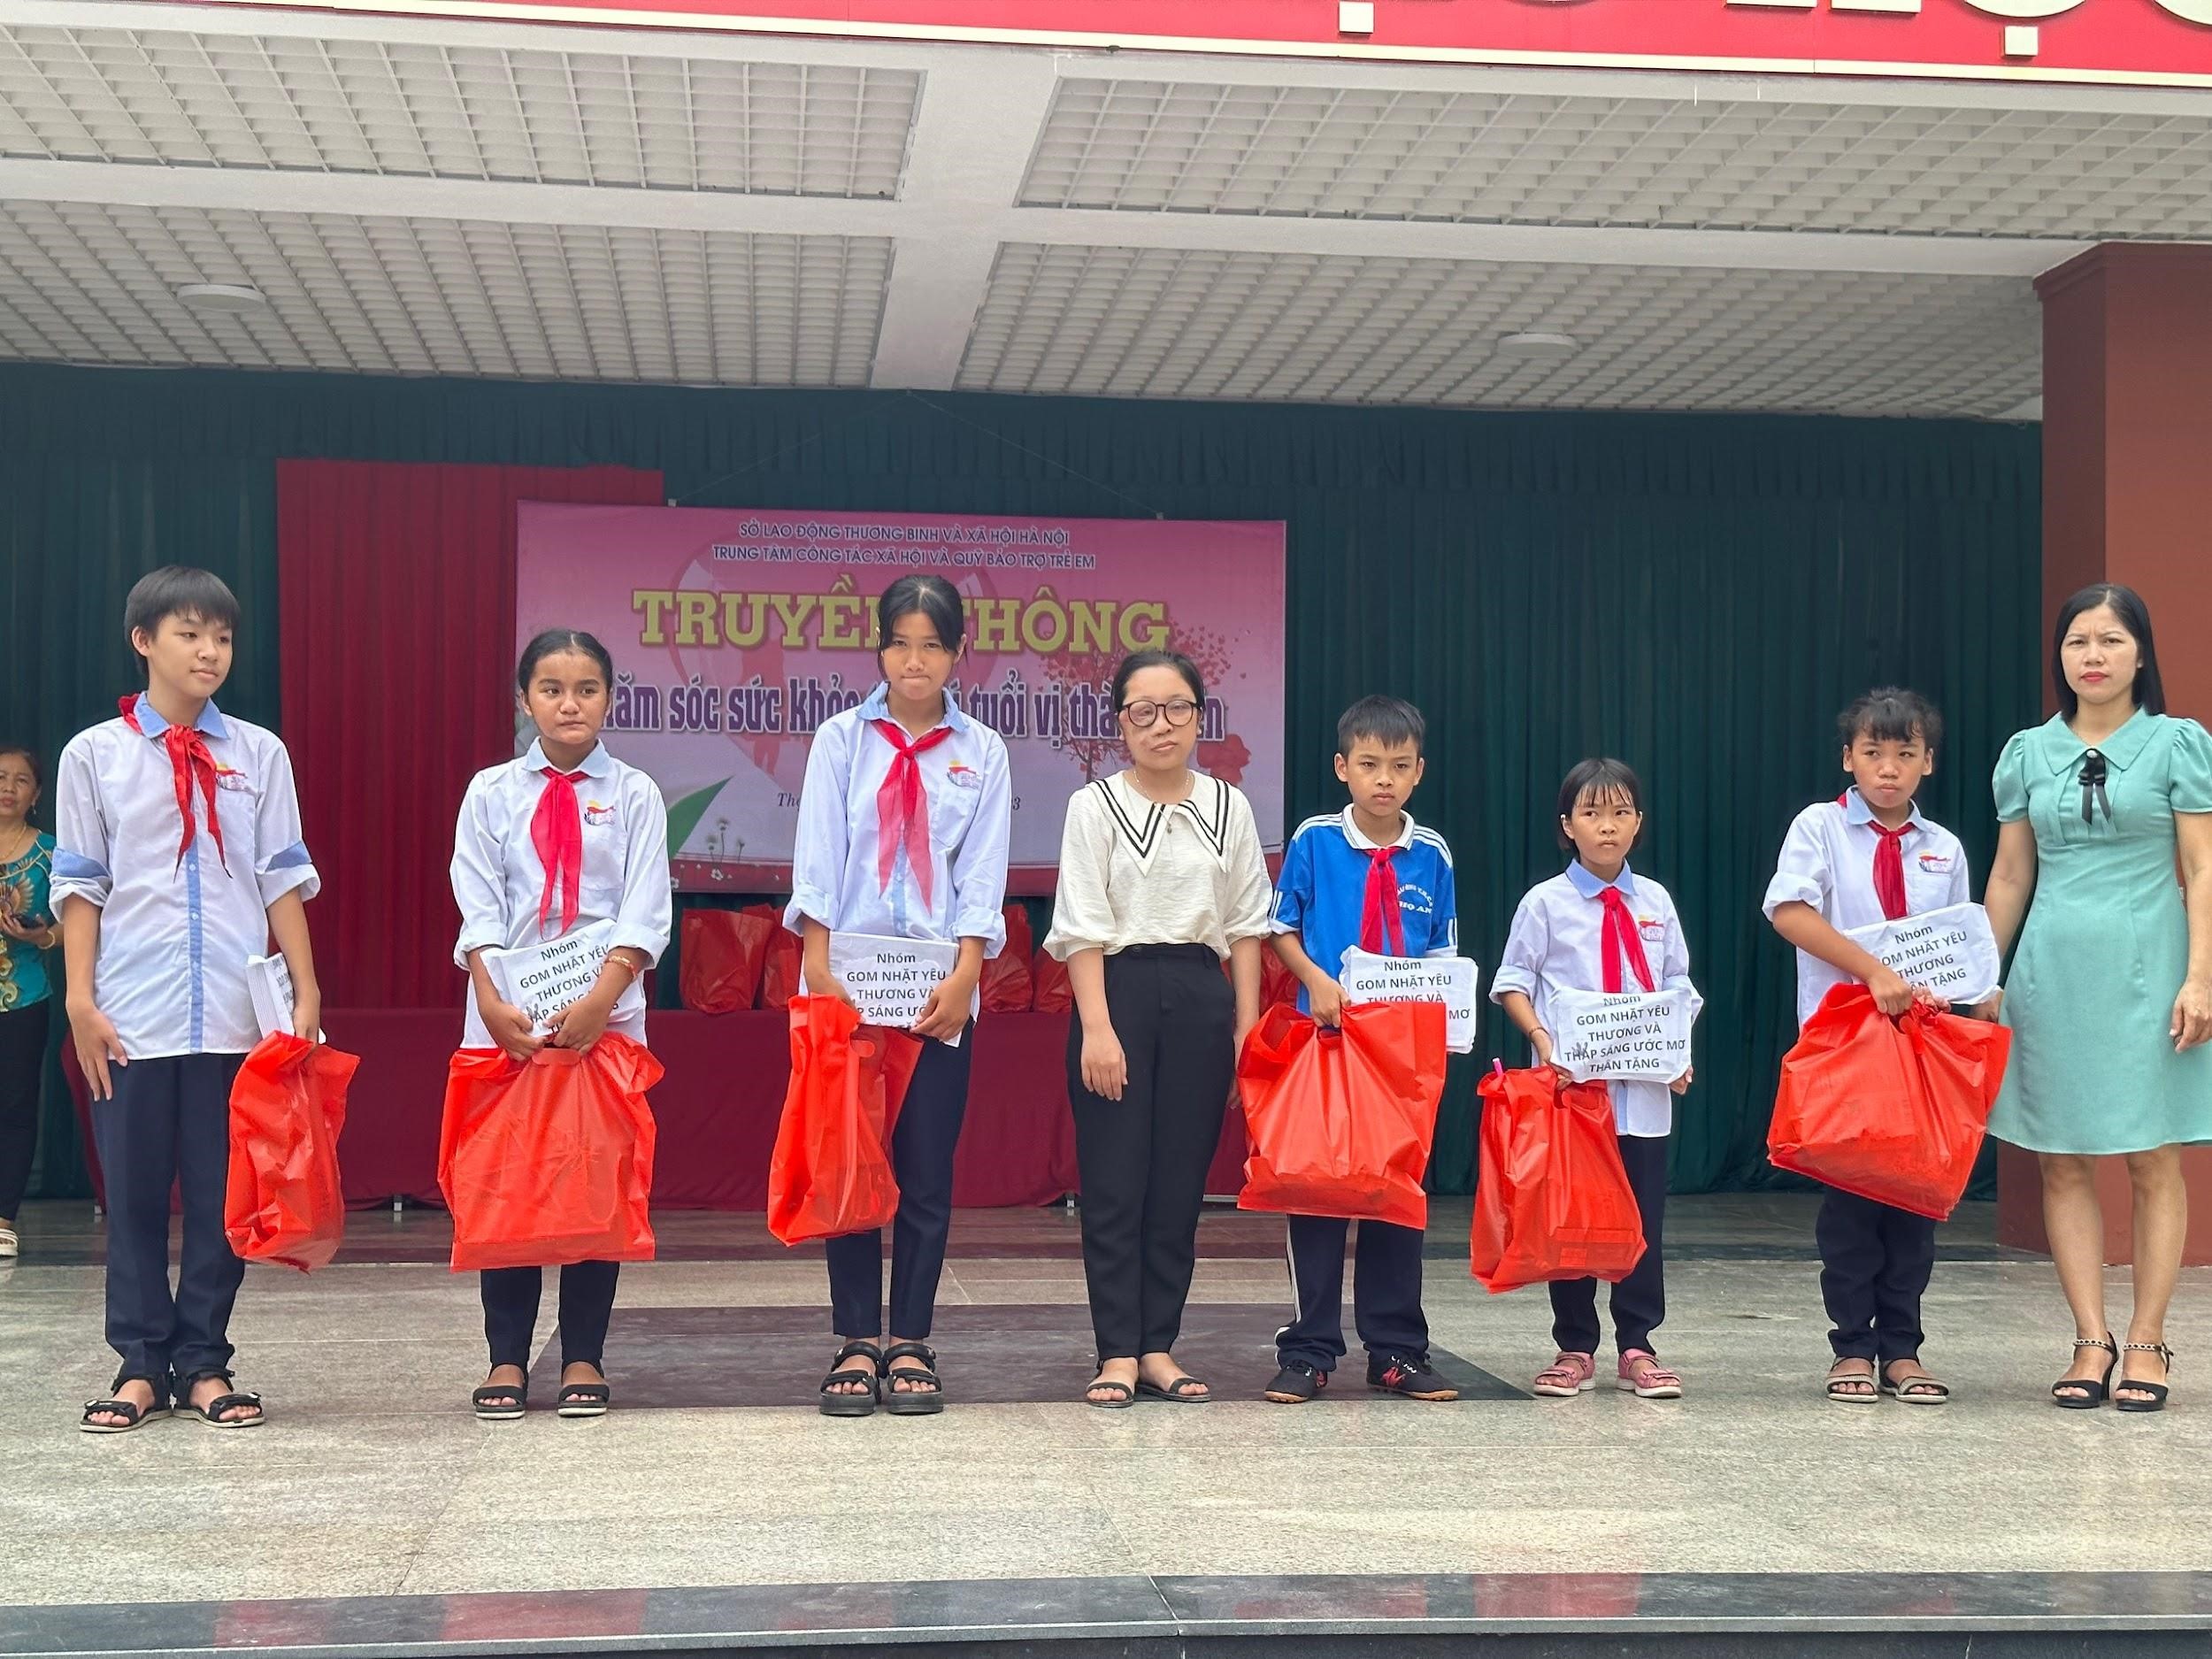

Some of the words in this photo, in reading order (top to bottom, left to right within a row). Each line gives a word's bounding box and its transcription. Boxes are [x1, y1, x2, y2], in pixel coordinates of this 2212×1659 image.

[740, 518, 759, 538] SỞ
[764, 523, 793, 538] LAO
[796, 522, 841, 541] ĐỘNG
[906, 527, 939, 541] BINH
[942, 524, 964, 542] VÀ
[965, 527, 987, 543] XÃ
[989, 527, 1016, 547] HỘI
[1019, 526, 1041, 544] HÀ
[1042, 528, 1069, 548] NỘI
[713, 545, 759, 560] TRUNG
[764, 544, 793, 561] TÂM
[796, 545, 841, 562] CÔNG
[844, 543, 872, 563] TÁC
[876, 547, 897, 564] XÃ
[900, 548, 926, 567] HỘI
[929, 547, 949, 565] VÀ
[987, 548, 1017, 566] BẢO
[1020, 552, 1047, 571] TRỢ
[1049, 549, 1071, 568] TRẺ
[1074, 555, 1095, 569] EM
[962, 586, 1171, 653] HÔNG
[603, 672, 662, 732] ăm
[668, 673, 721, 732] sóc
[726, 674, 782, 733] sức
[968, 668, 1029, 738] tuổi
[1033, 682, 1063, 749] vị
[1068, 681, 1121, 740] thà
[1895, 926, 1932, 945] Nhóm
[541, 940, 578, 962] Nhóm
[877, 952, 916, 964] Nhóm
[1881, 952, 1903, 966] OM
[1905, 939, 1940, 960] NHẶT
[1941, 930, 1967, 947] YÊU
[520, 969, 550, 989] GOM
[552, 953, 587, 977] NHẶT
[847, 972, 878, 982] GOM
[882, 967, 918, 984] NHẶT
[921, 968, 946, 981] YÊU
[1384, 959, 1422, 972] Nhóm
[1897, 954, 1954, 979] THƯƠNG
[1356, 979, 1386, 990] GOM
[1390, 974, 1425, 990] NHẶT
[1428, 973, 1452, 986] YÊU
[1932, 967, 1967, 987] TẶNG
[535, 974, 592, 1002] THƯƠNG
[856, 988, 916, 1000] THƯƠNG
[1426, 990, 1443, 1003] VÀ
[868, 1004, 903, 1018] SÁNG
[1448, 1009, 1471, 1019] MƠ
[1577, 1015, 1607, 1026] GOM
[1610, 1008, 1644, 1023] NHẶT
[1647, 1005, 1671, 1017] YÊU
[1587, 1025, 1641, 1041] THƯƠNG
[1644, 1021, 1662, 1034] VÀ
[1600, 1042, 1630, 1057] SÁNG
[1633, 1039, 1663, 1051] ƯỚC
[1666, 1040, 1686, 1050] MƠ
[1624, 1057, 1660, 1071] TẶNG
